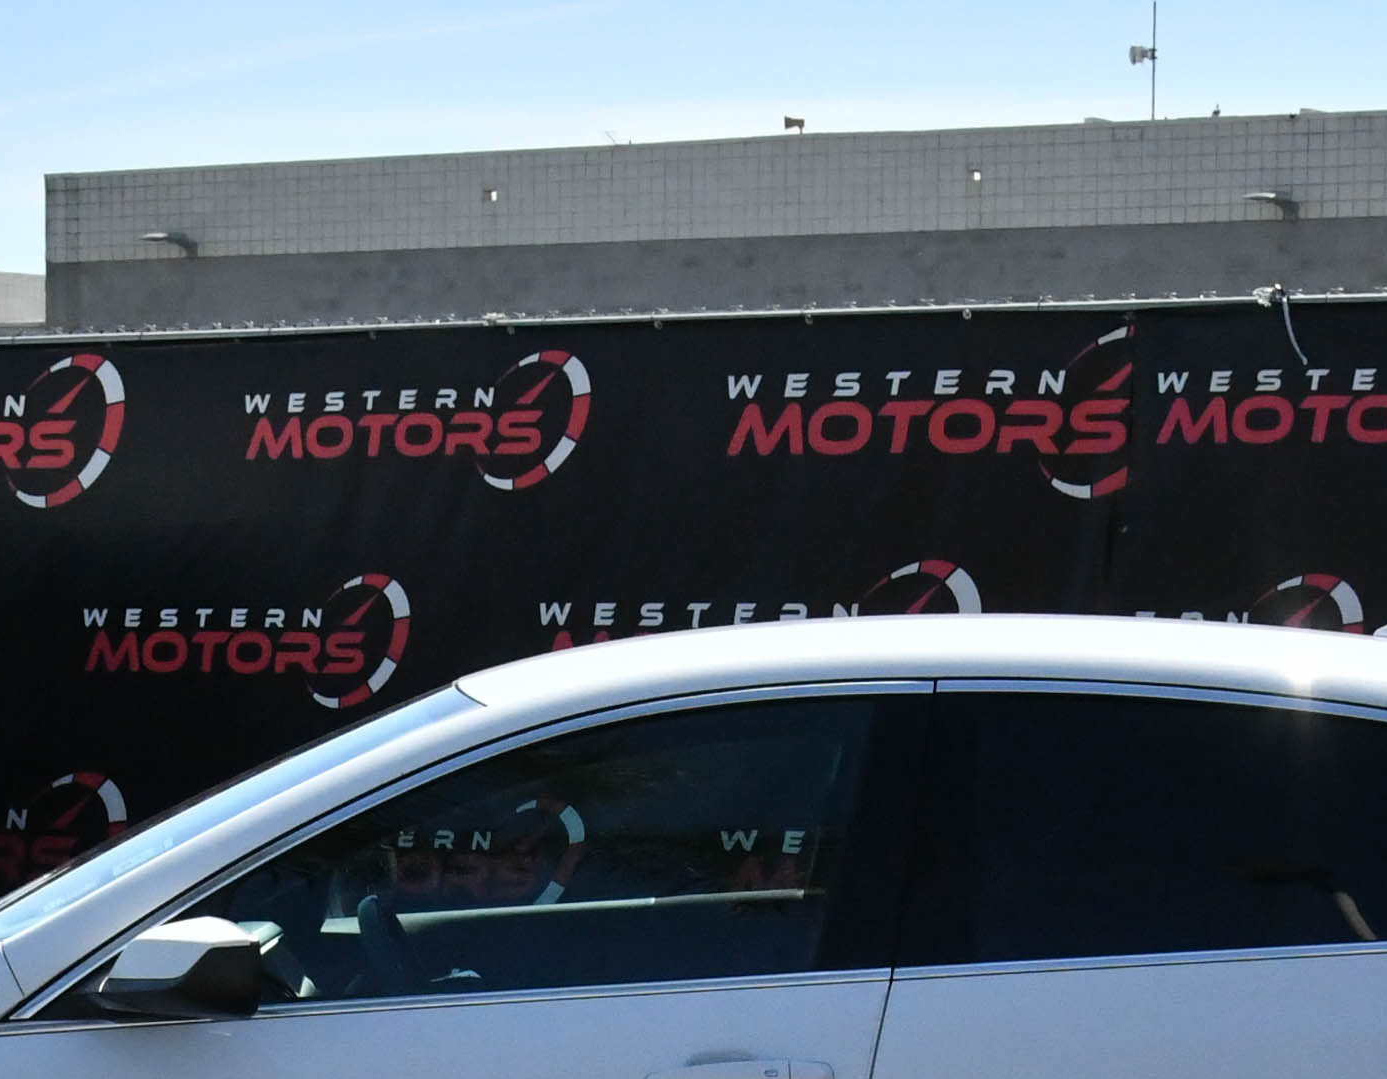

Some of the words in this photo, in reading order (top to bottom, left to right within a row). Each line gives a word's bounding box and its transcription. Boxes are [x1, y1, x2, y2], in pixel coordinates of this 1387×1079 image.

[245, 387, 494, 414] WESTERN
[728, 370, 1066, 399] WESTERN
[245, 410, 543, 459] MOTORS
[728, 398, 1130, 456] MOTORS
[84, 608, 322, 627] WESTERN
[87, 631, 365, 674] MOTORS
